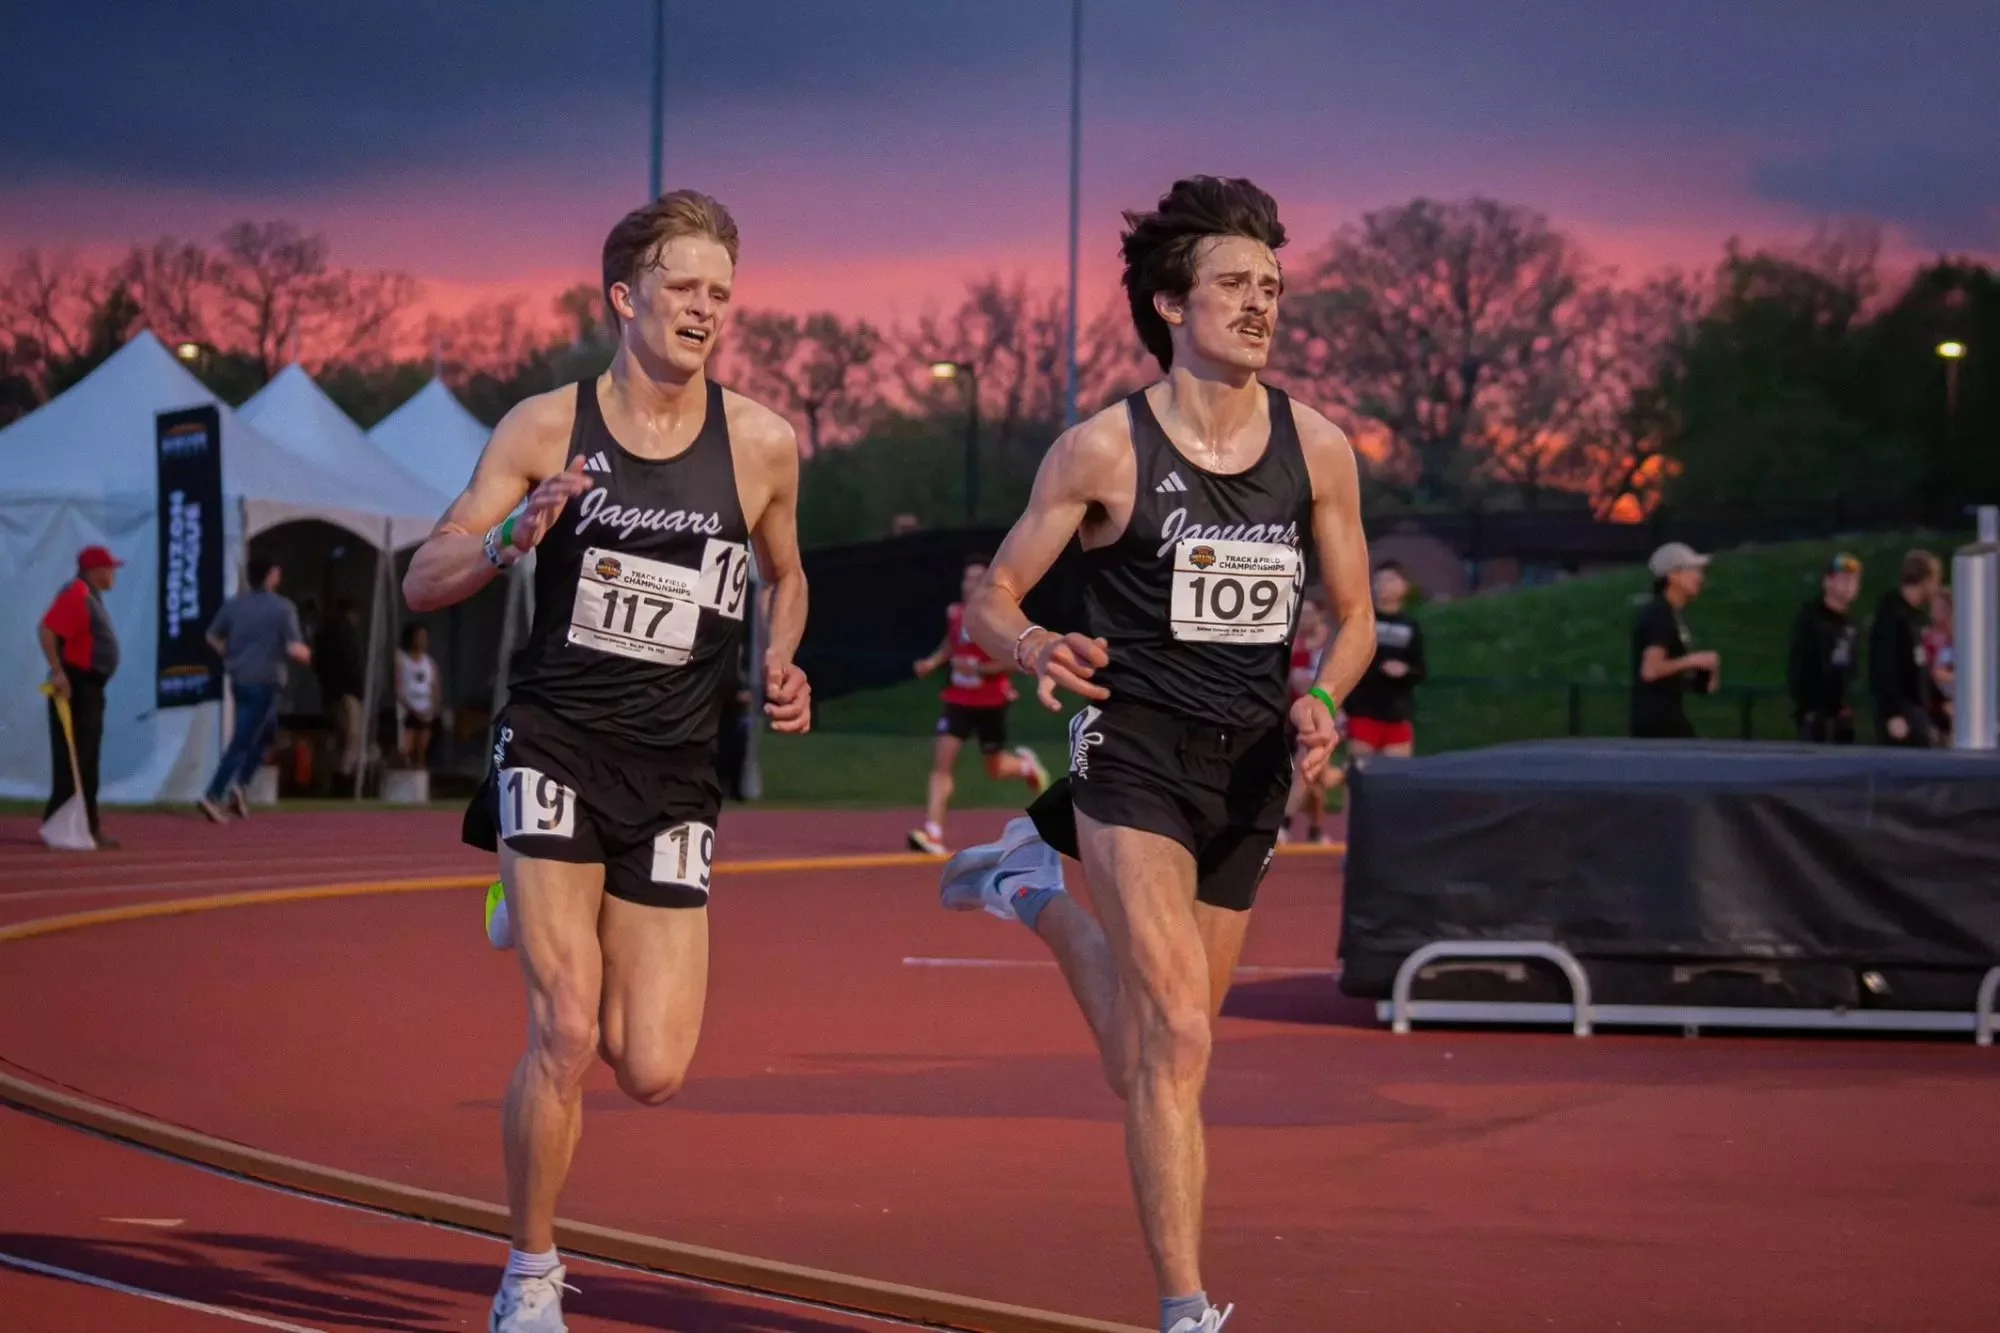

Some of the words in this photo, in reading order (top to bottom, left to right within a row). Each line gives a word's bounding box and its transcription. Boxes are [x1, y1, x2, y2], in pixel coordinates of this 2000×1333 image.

[575, 487, 722, 540] Jaguars
[1156, 507, 1299, 559] Jaguars
[631, 570, 657, 582] TRACK
[665, 578, 688, 589] FIELD
[714, 546, 748, 614] 19
[1219, 562, 1285, 572] CHAMPIONSHIPS
[1225, 555, 1251, 563] TRACK
[623, 575, 691, 597] CHAMPIONSHIPS
[1189, 576, 1279, 621] 109
[602, 589, 674, 639] 117
[506, 771, 566, 831] 19
[670, 825, 715, 885] 19
